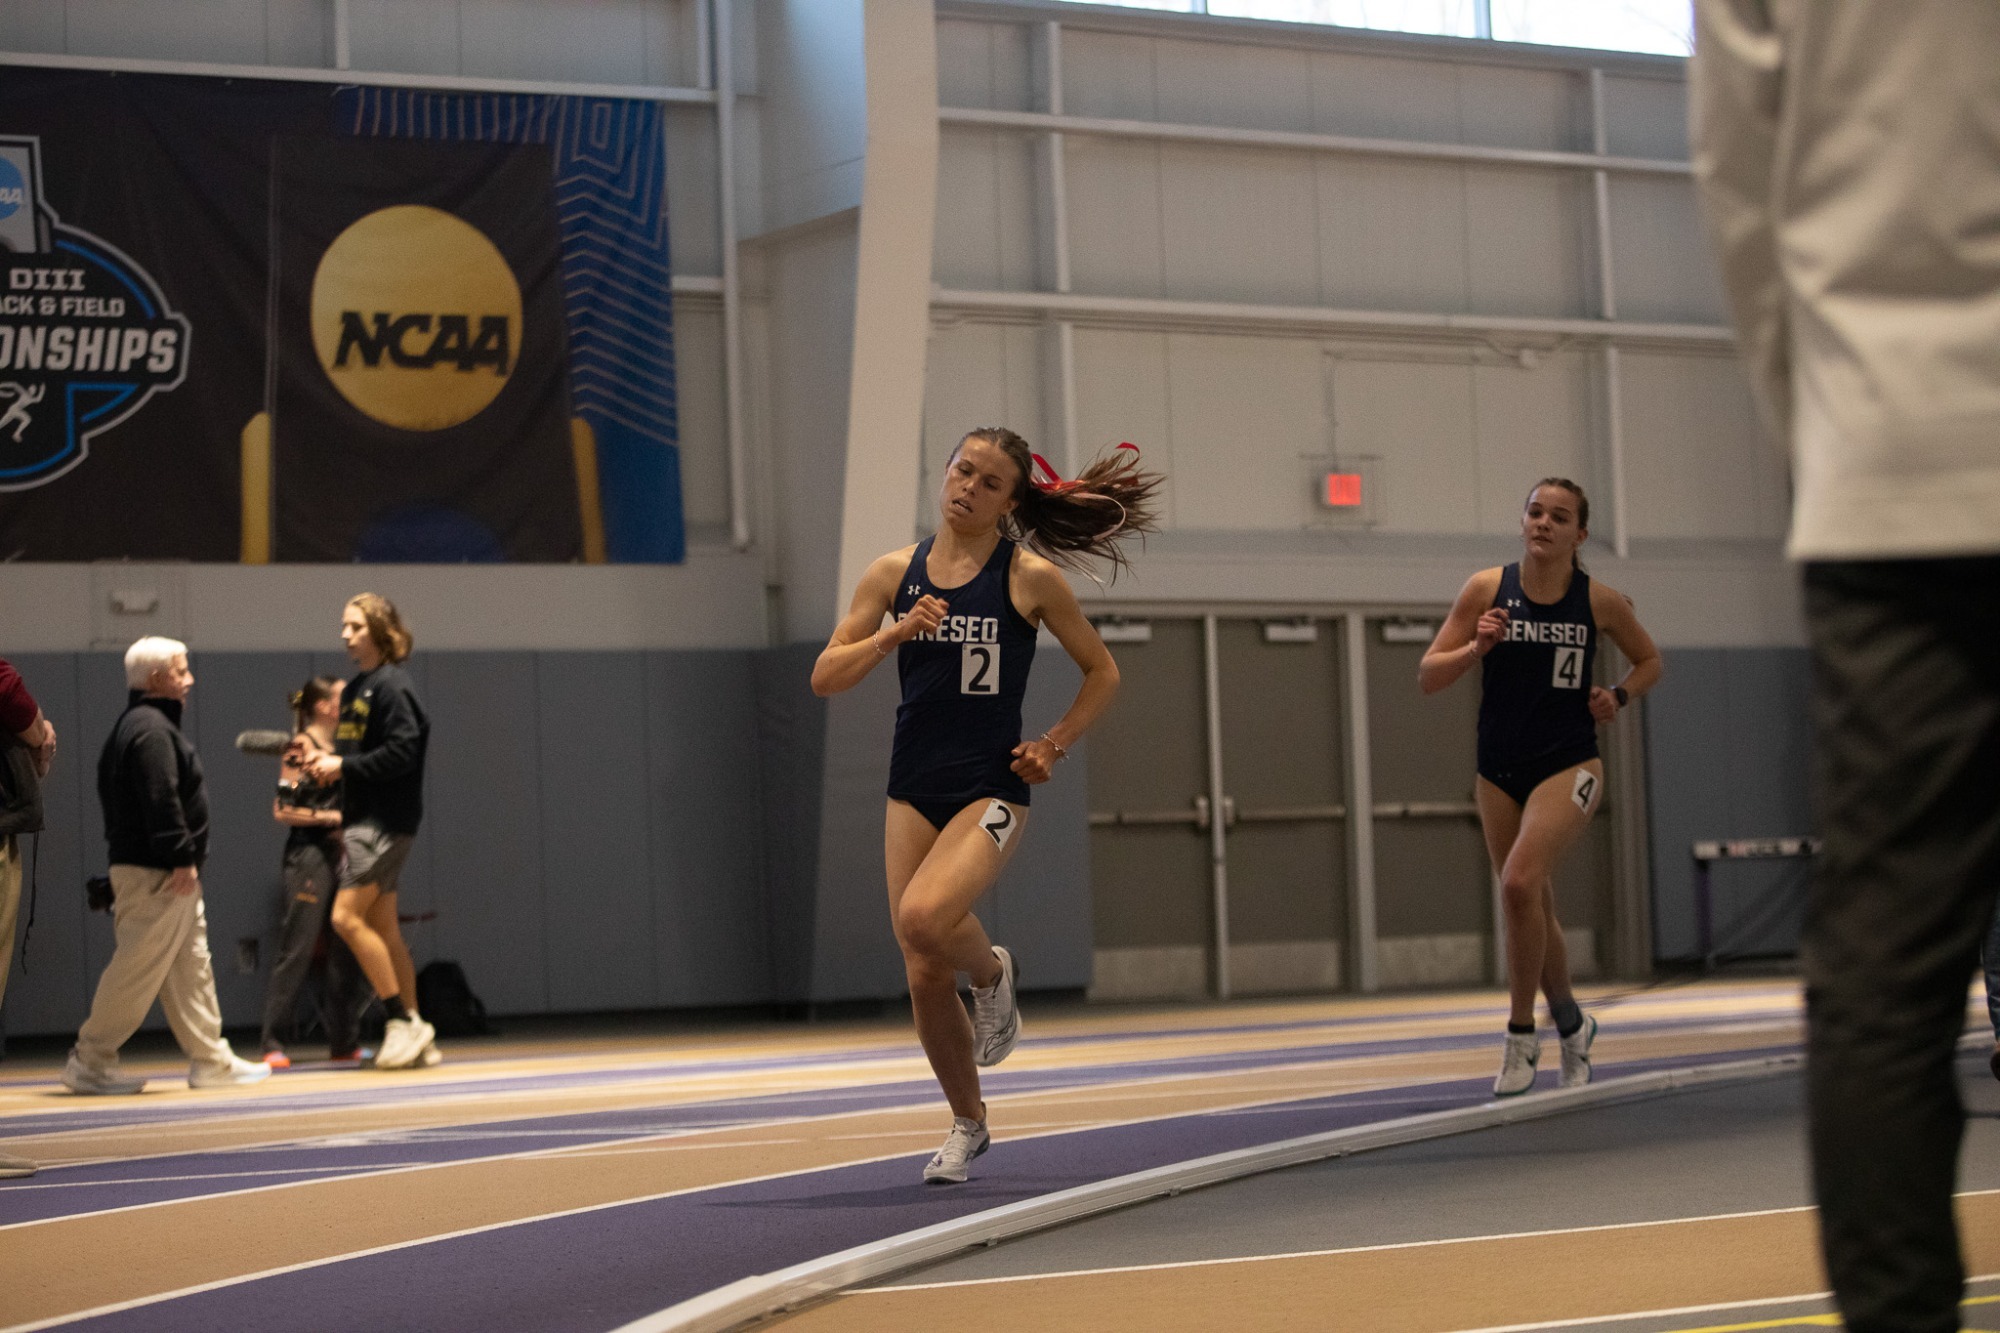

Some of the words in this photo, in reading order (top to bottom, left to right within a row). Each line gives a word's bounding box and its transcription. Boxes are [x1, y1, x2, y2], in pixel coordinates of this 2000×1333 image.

[9, 268, 86, 291] DIII
[0, 294, 35, 316] CK
[39, 296, 56, 316] &
[61, 296, 126, 318] FIELD
[332, 311, 509, 377] NCAA
[898, 612, 999, 644] ESEO
[968, 646, 991, 692] 2
[1558, 651, 1578, 687] 4
[1577, 777, 1595, 808] 4
[985, 804, 1011, 844] 2
